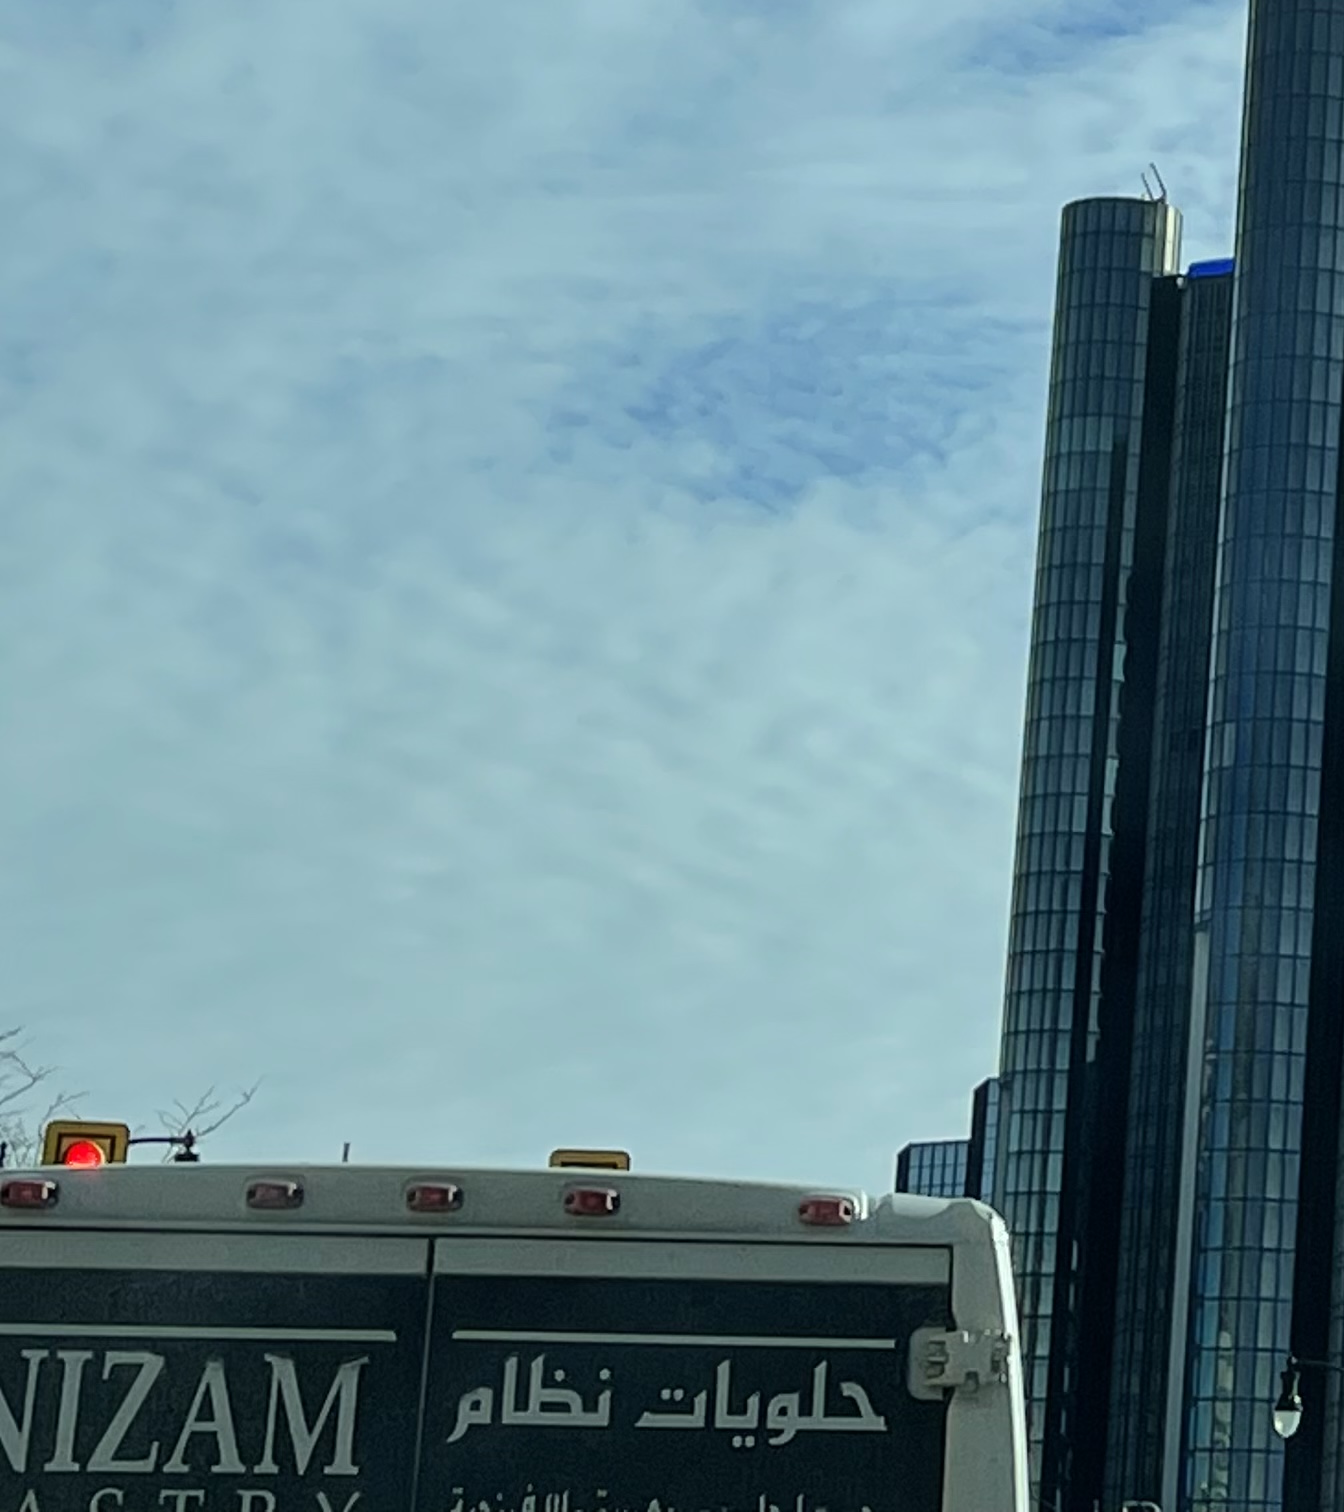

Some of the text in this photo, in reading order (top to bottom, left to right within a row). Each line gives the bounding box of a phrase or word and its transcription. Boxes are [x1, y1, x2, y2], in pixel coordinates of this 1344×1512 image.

[0, 1348, 370, 1476] NIZAM
[446, 1353, 888, 1446] حلويات نظام
